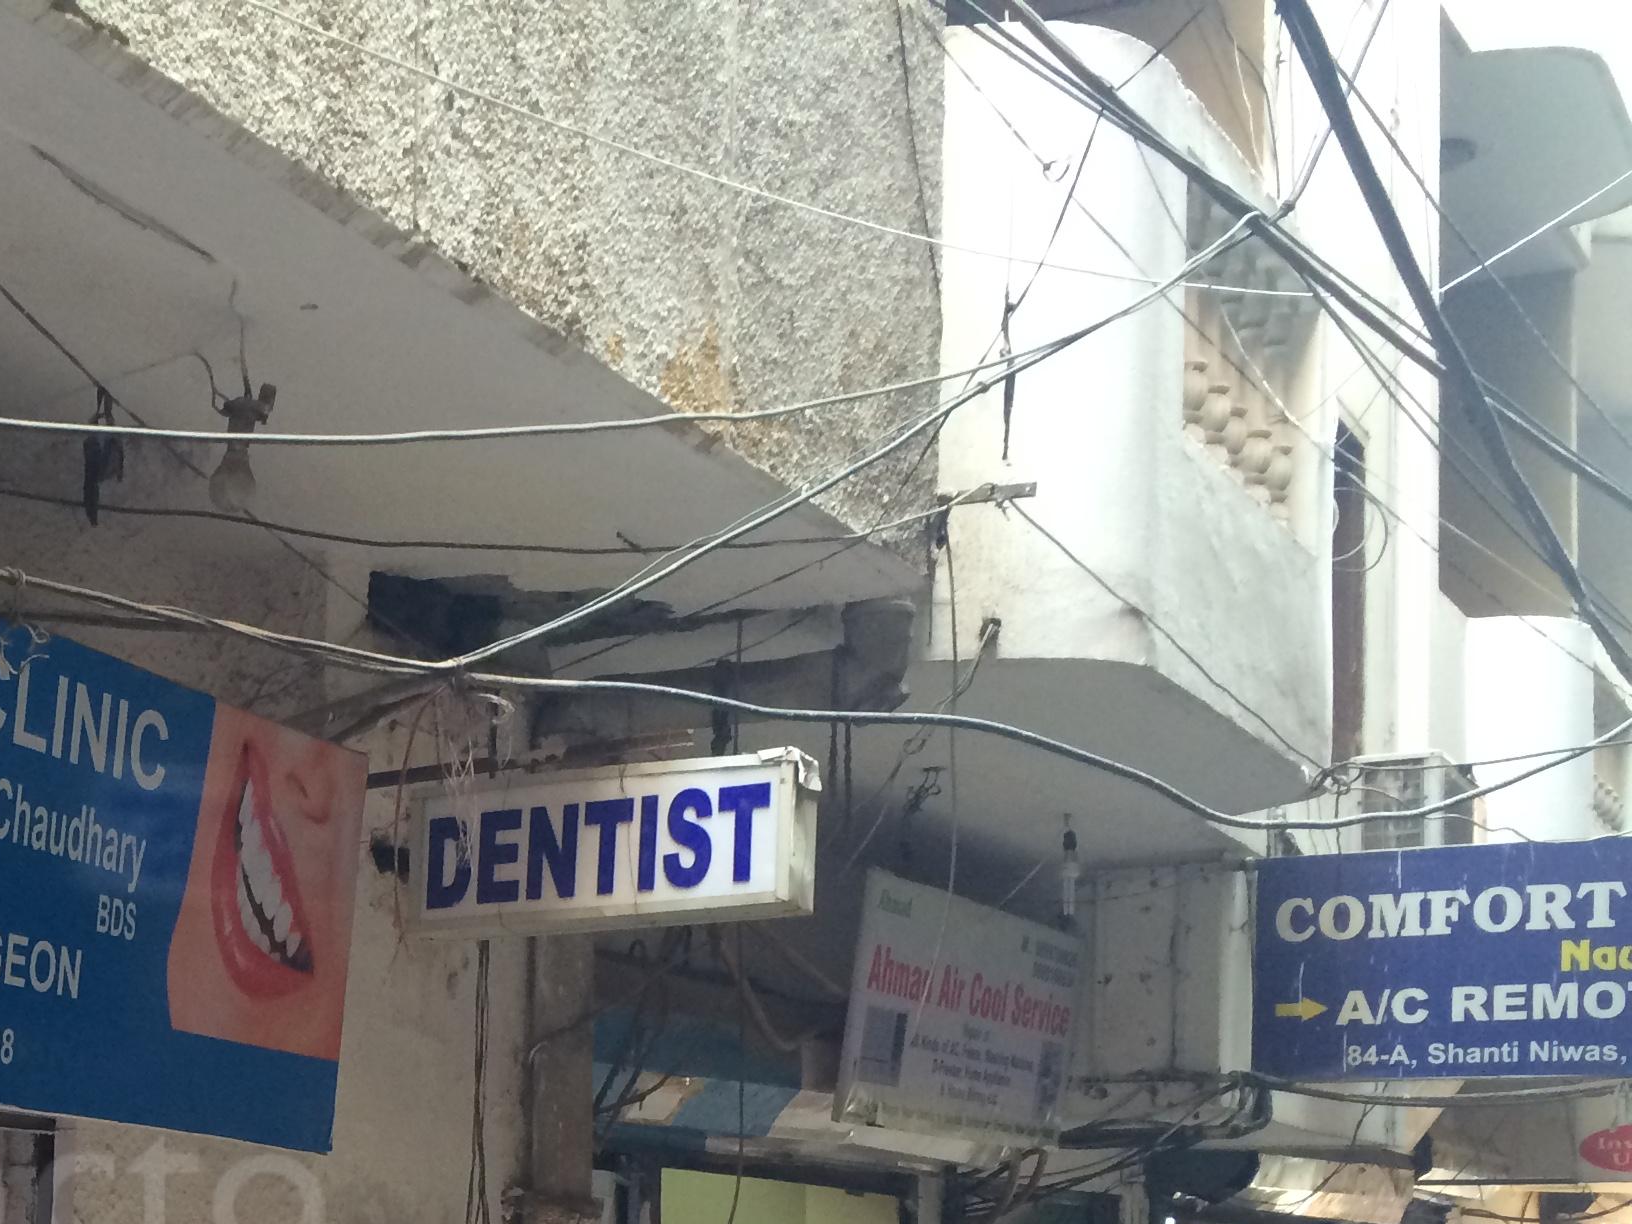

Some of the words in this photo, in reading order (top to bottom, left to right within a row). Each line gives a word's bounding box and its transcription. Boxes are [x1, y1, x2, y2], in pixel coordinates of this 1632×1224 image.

[425, 781, 771, 909] DENTIST
[96, 894, 137, 941] BDS
[1276, 881, 1627, 942] COMFORT
[937, 964, 965, 1012] Air
[969, 972, 1010, 1023] Cool
[1012, 983, 1071, 1038] Service
[1336, 988, 1428, 1026] A/C
[1450, 981, 1632, 1022] REMO
[1347, 1044, 1417, 1068] 84-A,
[1427, 1042, 1518, 1066] Shanti
[1529, 1040, 1627, 1066] Niwas,
